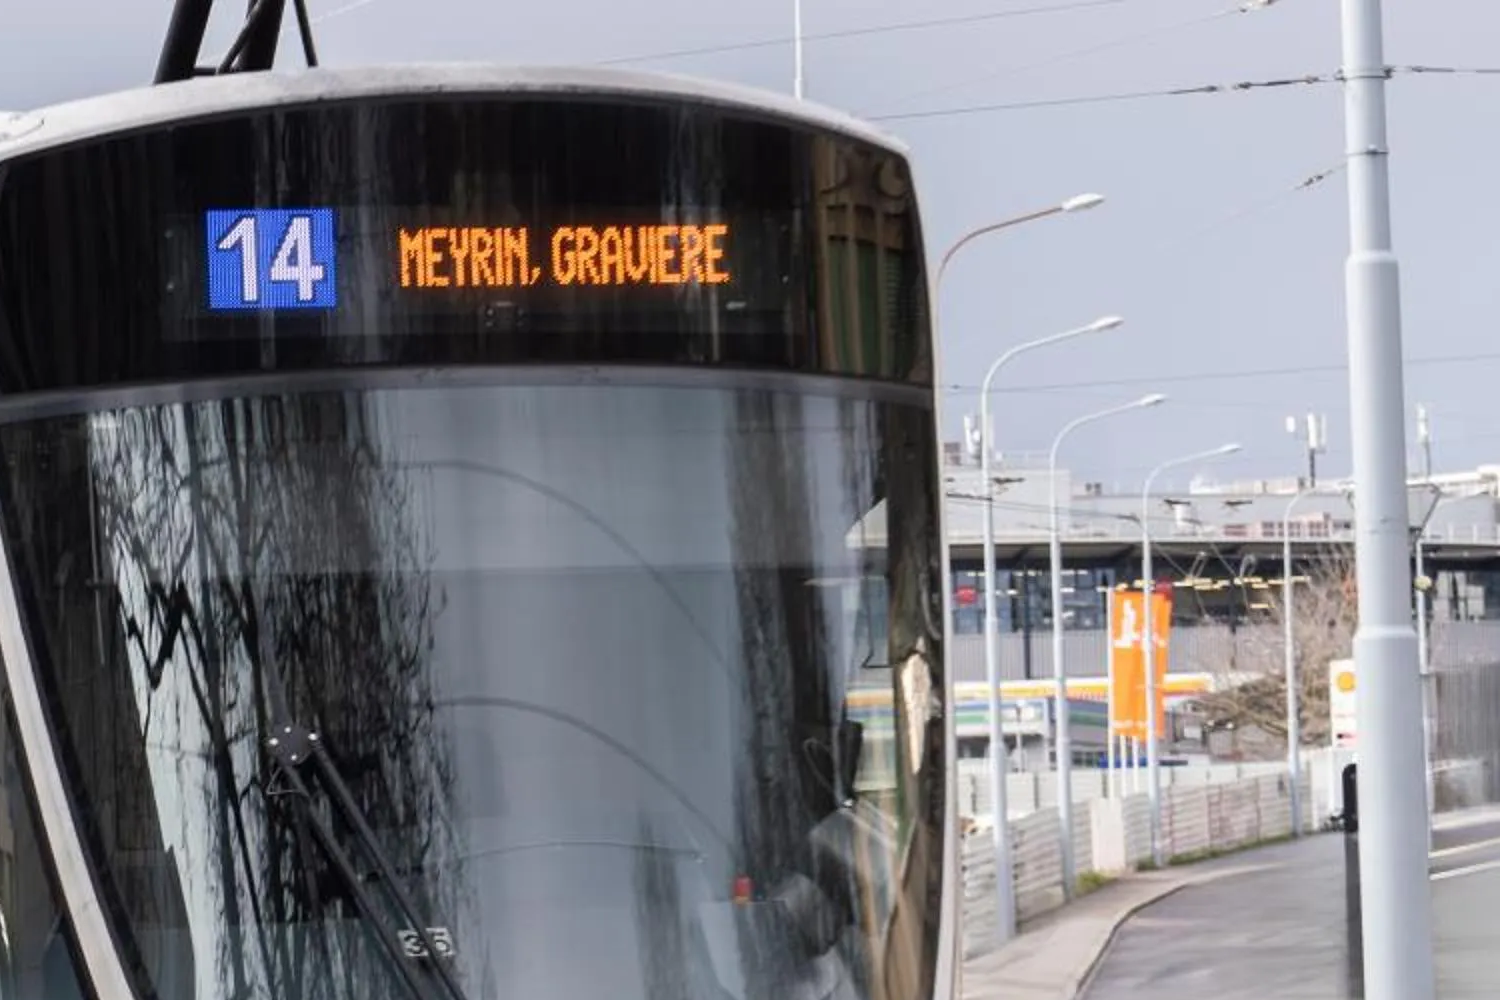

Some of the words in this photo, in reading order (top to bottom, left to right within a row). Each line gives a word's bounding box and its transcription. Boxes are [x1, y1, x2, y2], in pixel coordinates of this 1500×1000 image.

[218, 216, 323, 301] 14
[399, 226, 542, 287] MEYRIN,
[551, 224, 731, 285] GRAVIERE
